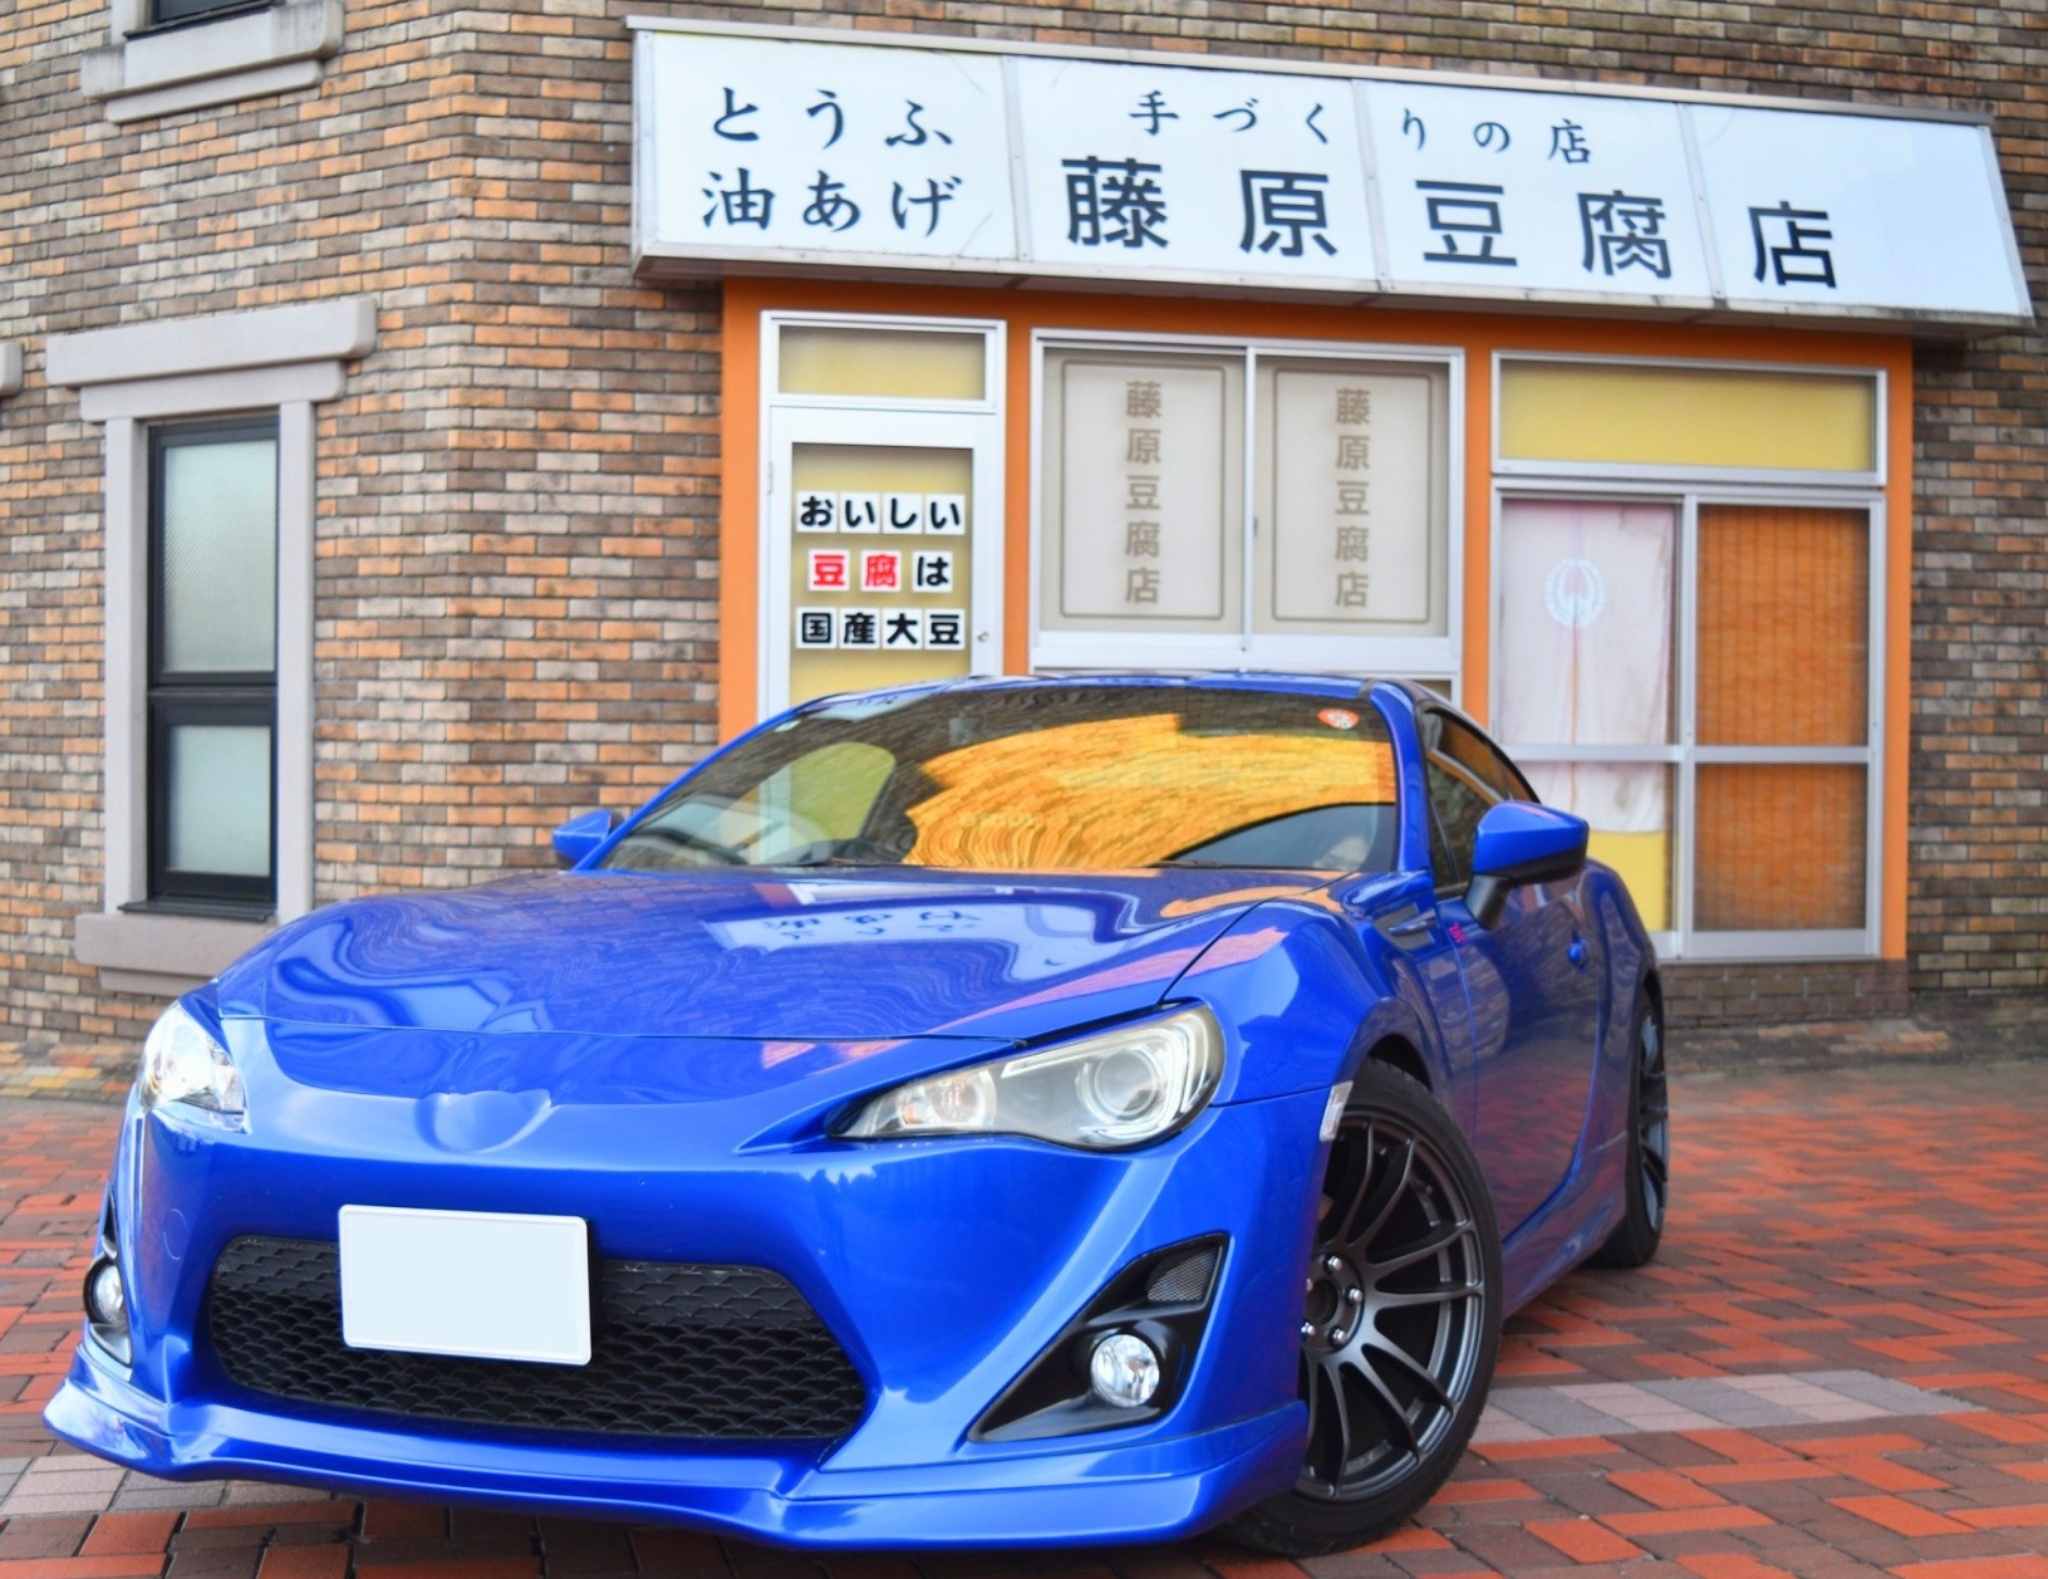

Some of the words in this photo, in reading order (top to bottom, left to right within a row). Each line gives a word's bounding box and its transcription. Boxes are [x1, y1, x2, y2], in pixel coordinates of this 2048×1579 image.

[712, 87, 953, 149] とうふ
[1129, 90, 1592, 164] 手づくりの店
[702, 167, 963, 238] 油あげ
[1061, 155, 1838, 289] 藤原豆腐店
[800, 496, 961, 529] おいしい
[1125, 380, 1162, 605] 藤原豆腐店
[1334, 388, 1371, 608] 藤原豆腐店
[813, 554, 949, 588] 豆腐は
[801, 612, 960, 645] 国産大豆
